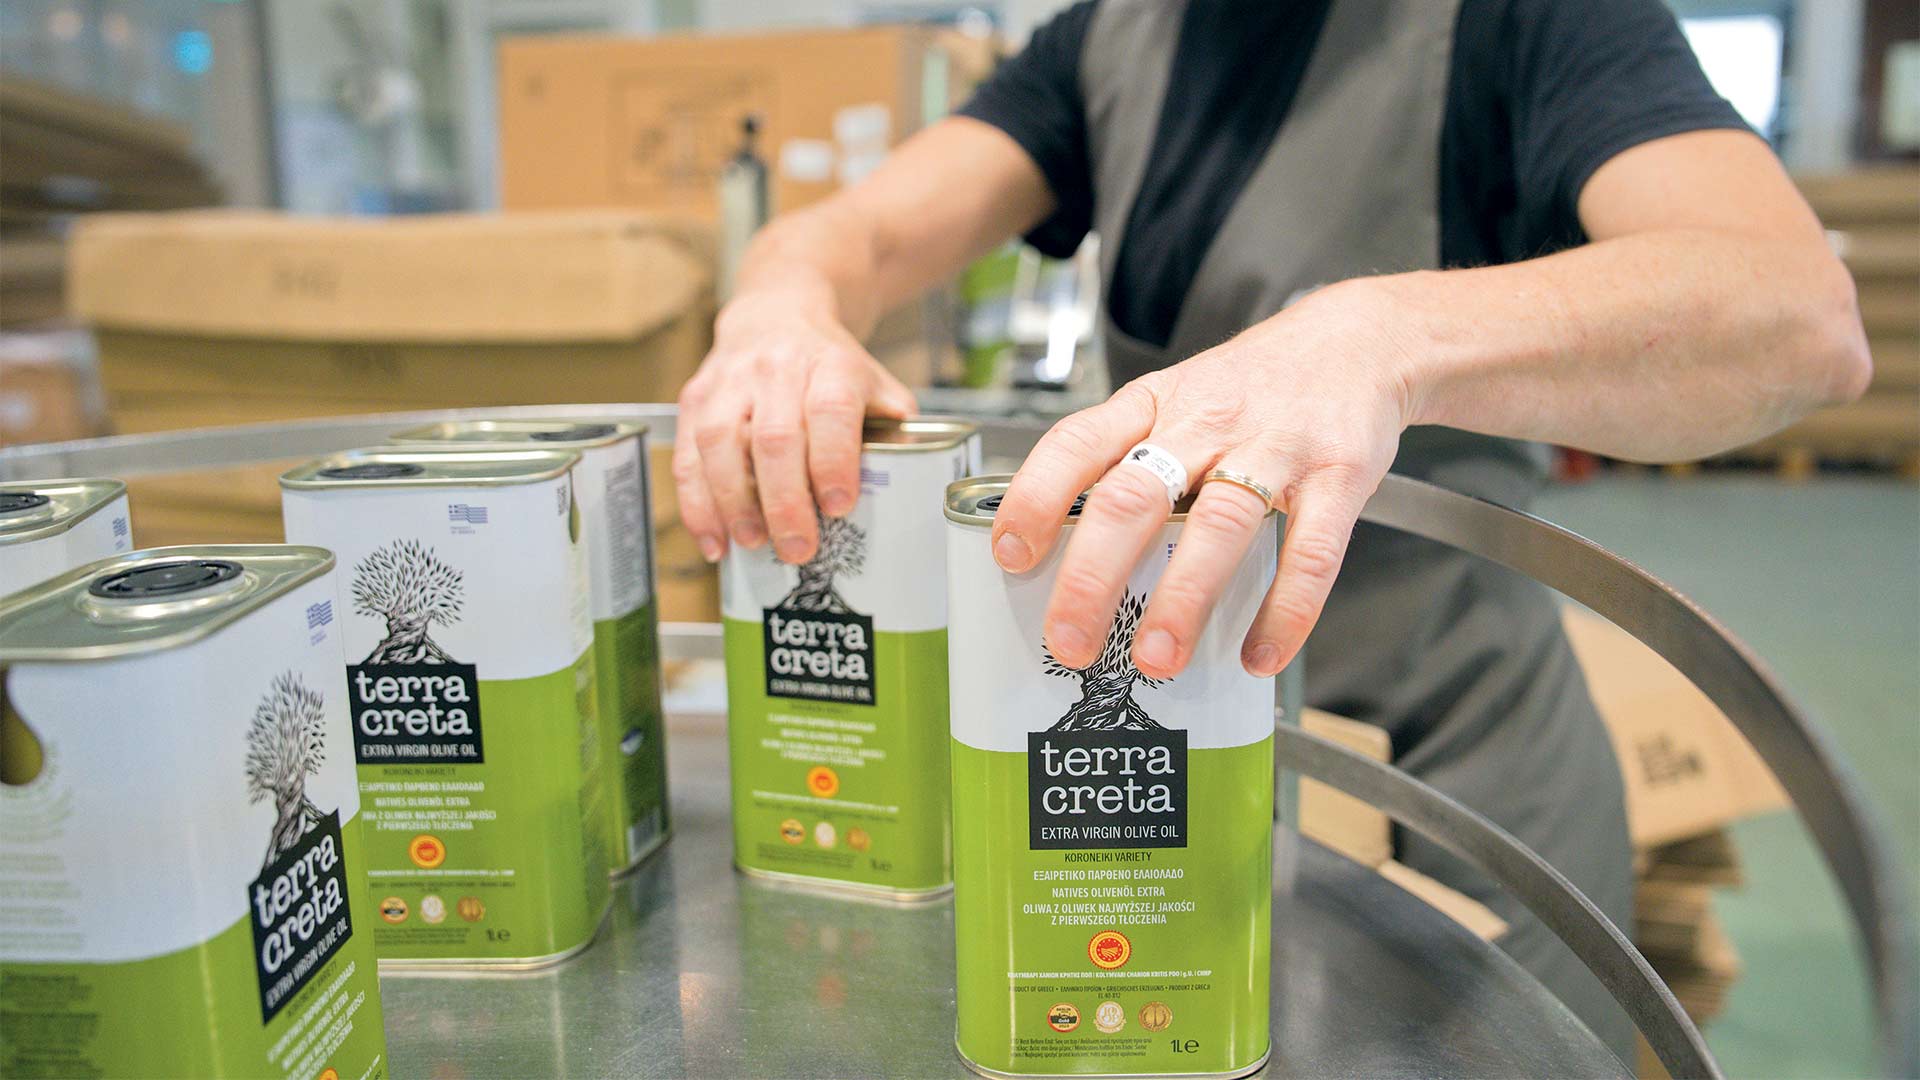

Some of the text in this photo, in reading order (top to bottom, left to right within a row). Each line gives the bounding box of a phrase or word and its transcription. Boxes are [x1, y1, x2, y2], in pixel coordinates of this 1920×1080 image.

[769, 612, 868, 650] terra
[770, 647, 869, 680] creta
[355, 670, 471, 703] terra
[359, 703, 473, 736] creta
[361, 744, 478, 757] EXTRA VIRGIN OLIVE OIL
[1040, 741, 1175, 776] terra
[1042, 778, 1175, 814] creta
[1041, 825, 1179, 840] EXTRA VIRGIN OLIVE OIL
[1064, 852, 1152, 863] KORONEIKI VARIETY
[254, 834, 339, 929] terra
[1033, 868, 1184, 881] ΕΞΑΙΡΕΤΙΚΟ ΠΑΡΘΕΝΟ ΕΛΑΙΟΛΑΔΟ
[1023, 899, 1195, 914] OLIWA Z OLIWEK NAJWYŻSZEJ JAKOŚCI
[1052, 885, 1166, 898] NATIVES OLIVENÖL EXTRA
[262, 877, 344, 974] creta
[1051, 914, 1167, 926] Z PIERWSZEGO TŁOCZENIA
